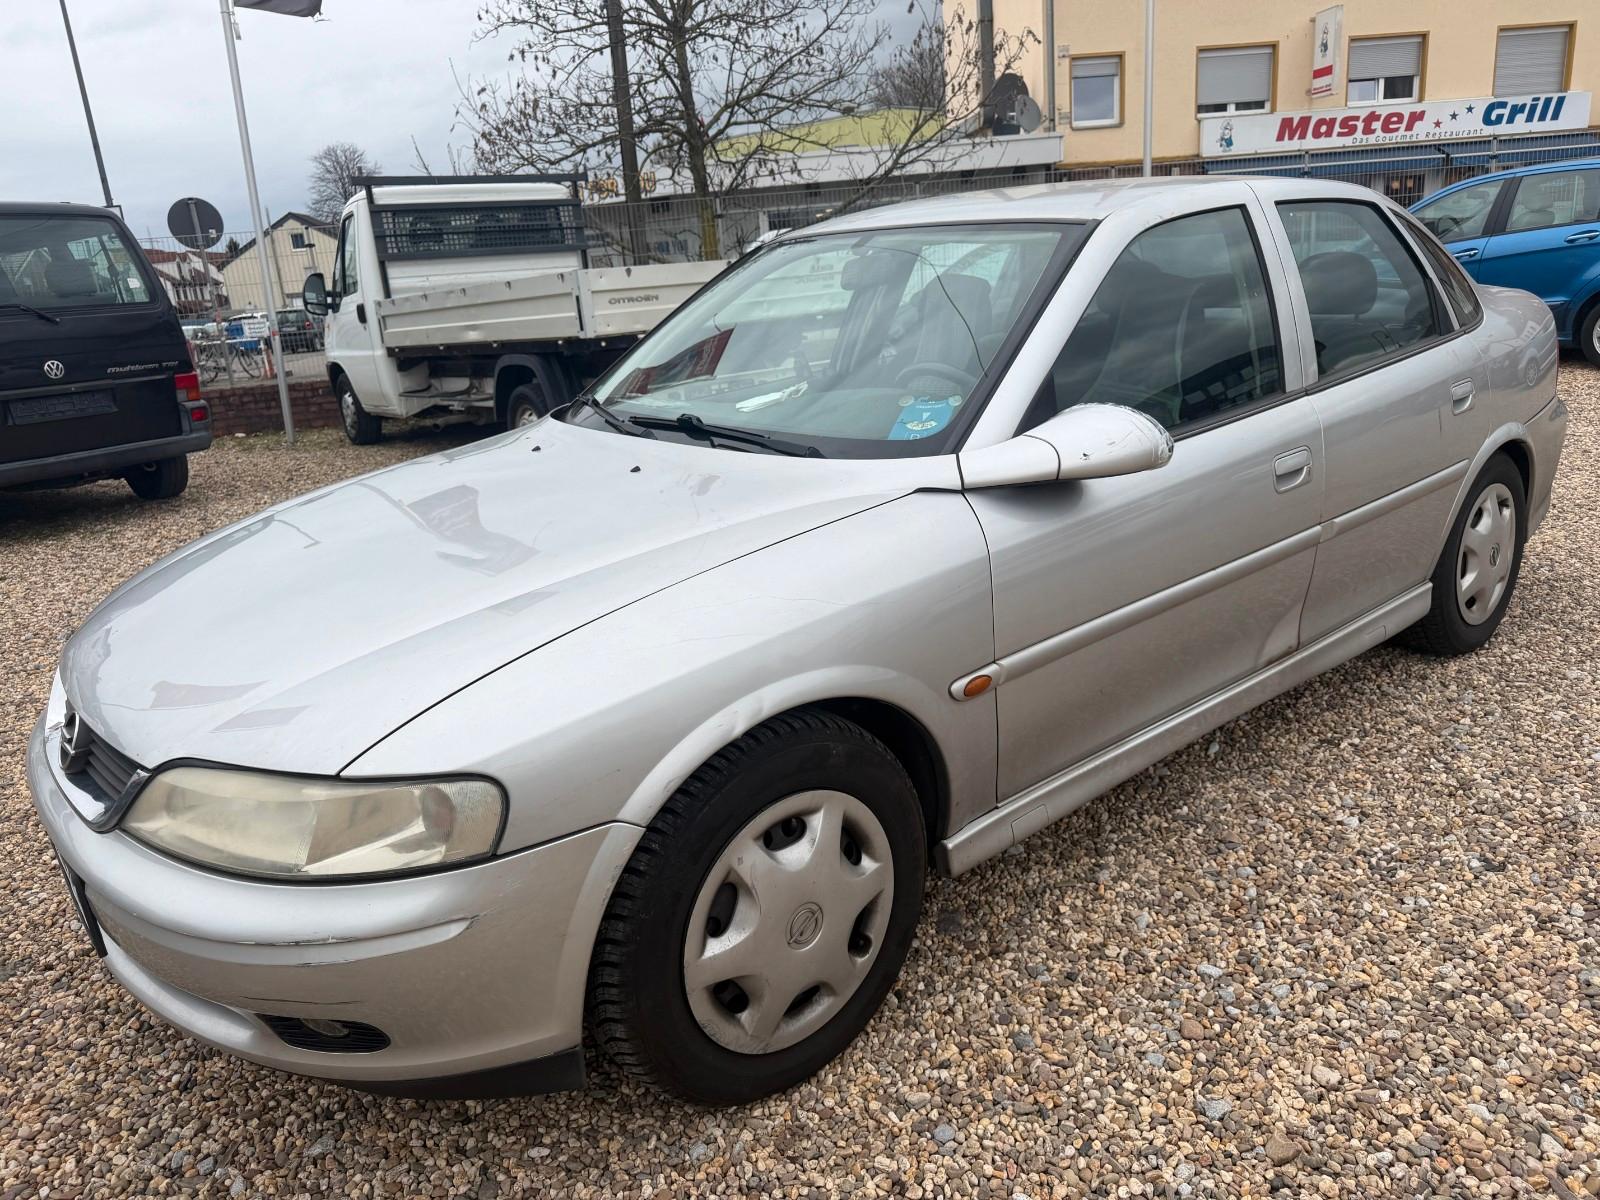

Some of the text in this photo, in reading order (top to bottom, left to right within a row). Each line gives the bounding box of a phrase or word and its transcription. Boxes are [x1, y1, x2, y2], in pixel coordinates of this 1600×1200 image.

[1276, 95, 1566, 142] Master Grill
[1352, 127, 1484, 145] Das Gourmet Restaurant
